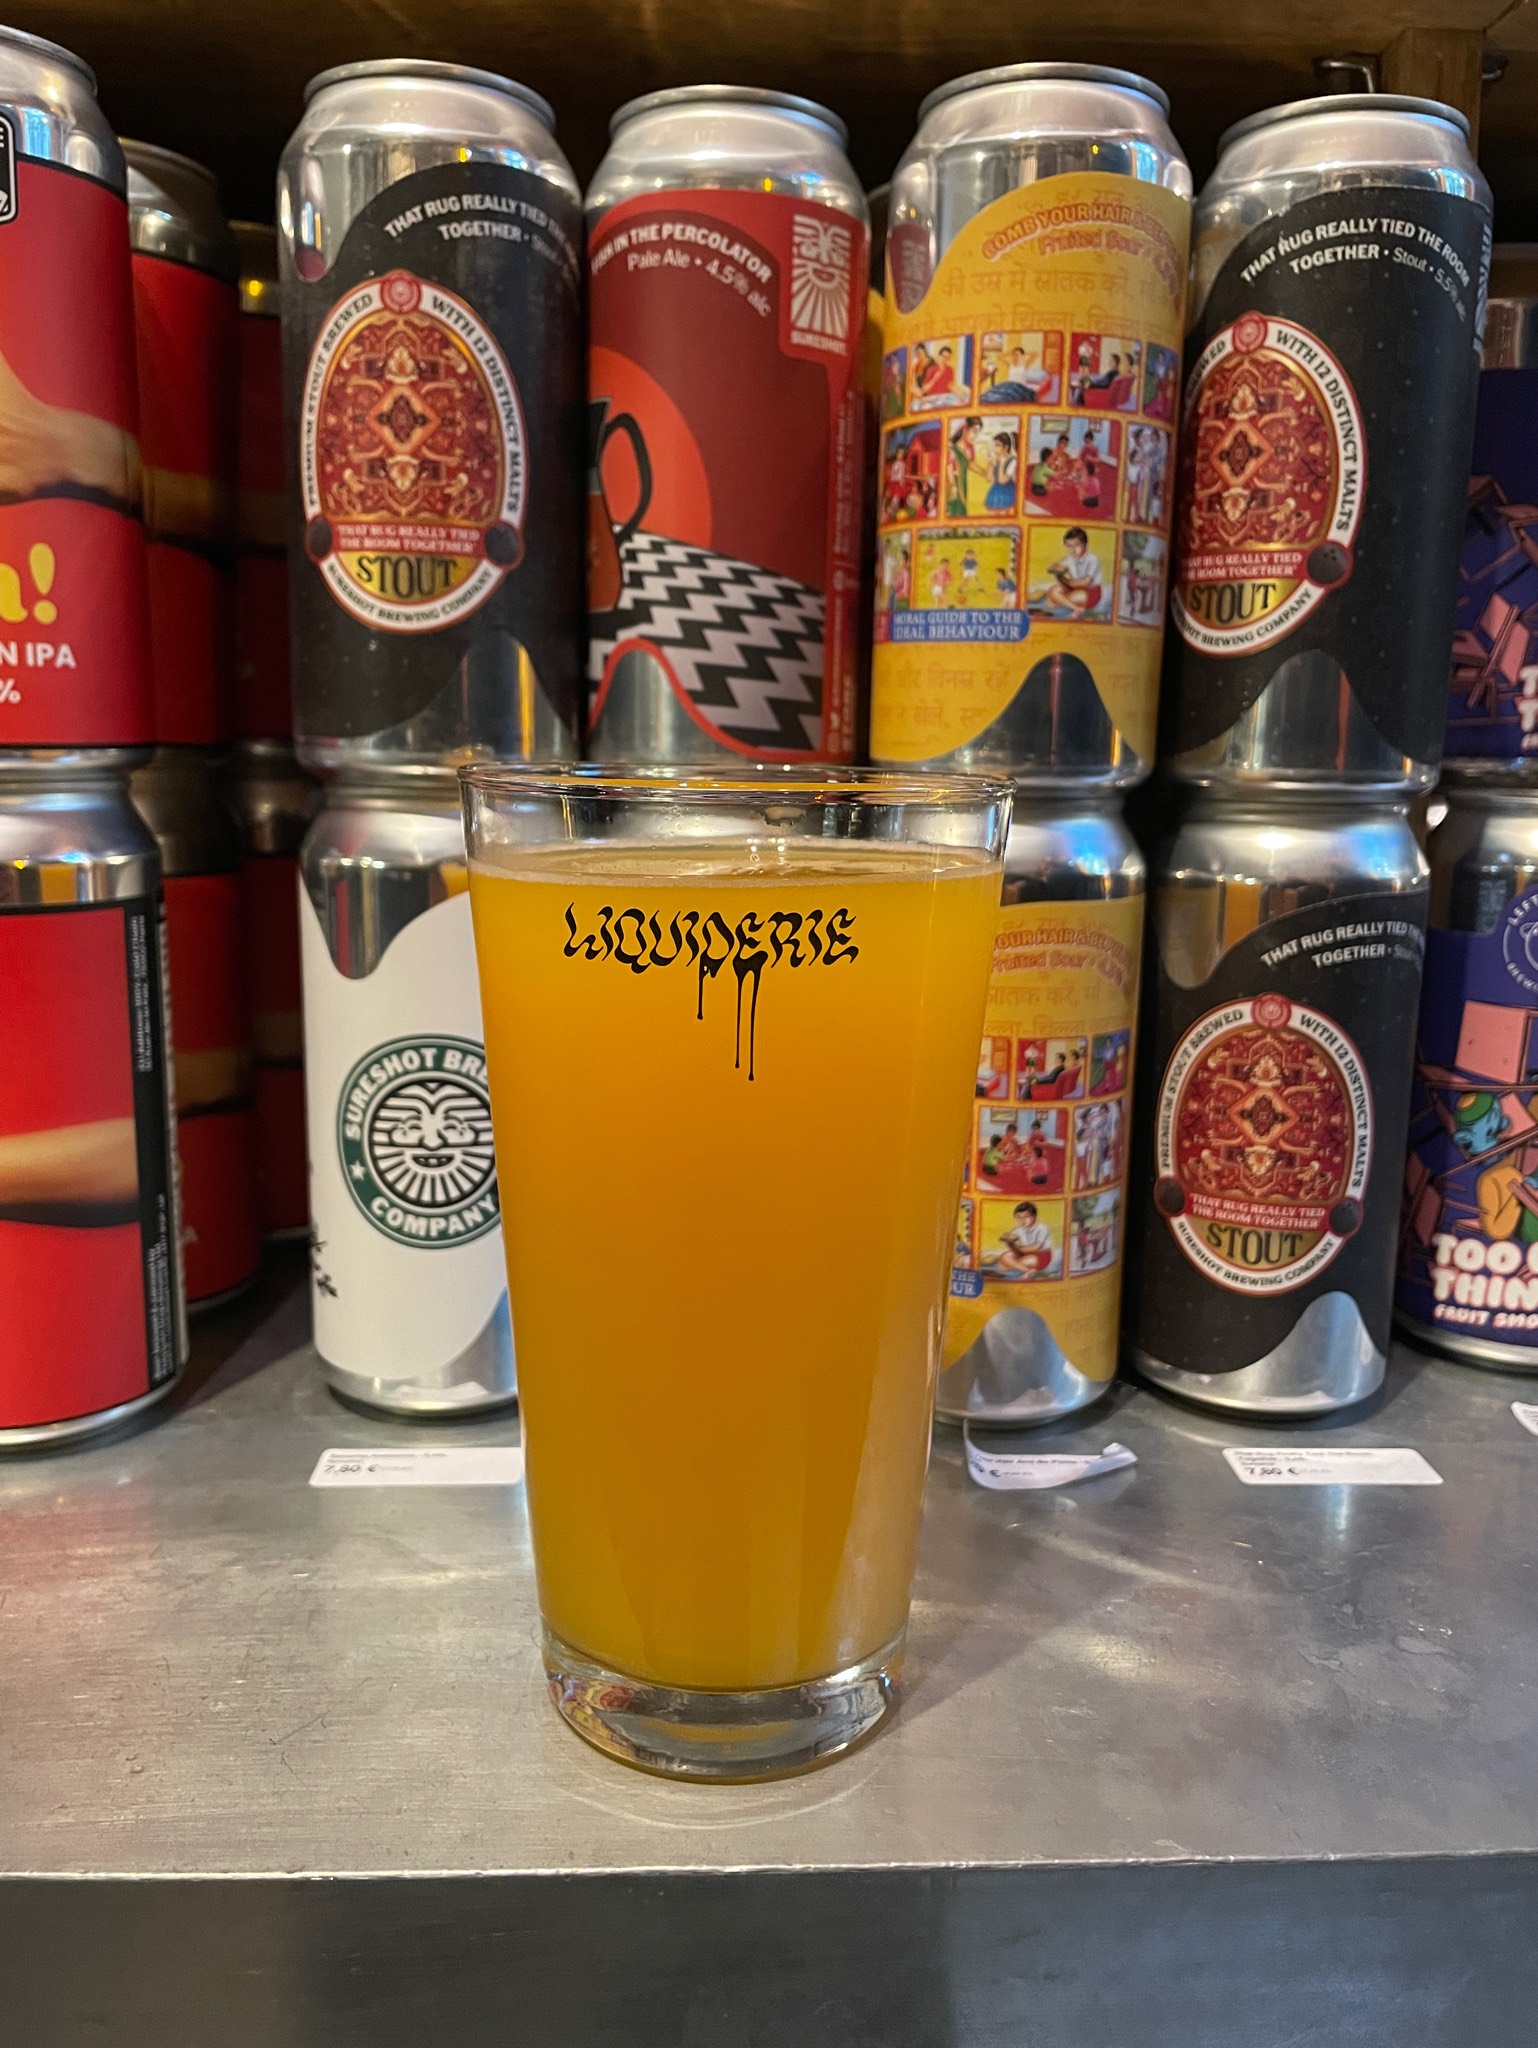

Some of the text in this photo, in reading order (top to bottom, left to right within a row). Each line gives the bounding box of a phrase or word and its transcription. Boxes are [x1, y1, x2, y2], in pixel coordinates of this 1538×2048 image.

[384, 204, 424, 238] THAT
[424, 196, 461, 218] RUG
[461, 194, 521, 214] REALLY
[438, 220, 522, 242] TOGETHER
[982, 216, 1041, 260] COMB
[1038, 203, 1090, 229] YOUR
[1092, 203, 1133, 224] HAIR
[613, 232, 629, 253] IN
[629, 224, 660, 245] THE
[661, 223, 773, 284] PERCOLATOR
[627, 250, 661, 272] Pale
[662, 247, 691, 268] Ale
[705, 257, 750, 296] 4.5%
[1240, 217, 1471, 289] THAT RUG REALLY TIED THE ROOM
[1289, 244, 1380, 274] TOGETHER
[1392, 246, 1428, 272] Stout
[431, 296, 521, 512] WITH 12 DISTINCT MALTS
[1277, 330, 1358, 531] WITH 12 DISTINCT MALTS
[357, 555, 458, 599] STOUT
[1225, 552, 1268, 564] REALLY
[1272, 551, 1302, 563] TIED
[927, 610, 968, 626] GUIDE
[970, 611, 989, 624] TO
[992, 611, 1021, 625] THE
[1191, 583, 1276, 625] STOUT
[1201, 631, 1255, 647] BREWING
[1256, 586, 1313, 637] COMPANY
[927, 625, 1020, 640] BEHAVIOUR
[25, 642, 77, 669] IPA
[1034, 927, 1075, 946] HAIR
[1260, 938, 1300, 968] THAT
[1300, 928, 1334, 950] RUG
[1335, 921, 1385, 942] REALLY
[1386, 920, 1408, 934] TIED
[1311, 943, 1386, 968] TOGETHER
[1190, 1008, 1244, 1048] BREWED
[345, 1047, 438, 1141] SURESHOT
[1300, 1012, 1370, 1188] WITH 12 DISTINCT MALTS
[370, 1192, 498, 1237] COMPANY
[1191, 1193, 1326, 1218] THAT RUG REALLY TIED
[1192, 1205, 1214, 1218] THE
[1215, 1210, 1250, 1224] ROOM
[1206, 1222, 1303, 1266] STOUT
[1431, 1232, 1522, 1275] TOO
[1224, 1269, 1284, 1286] BREWING
[1434, 1303, 1490, 1326] FRUIT
